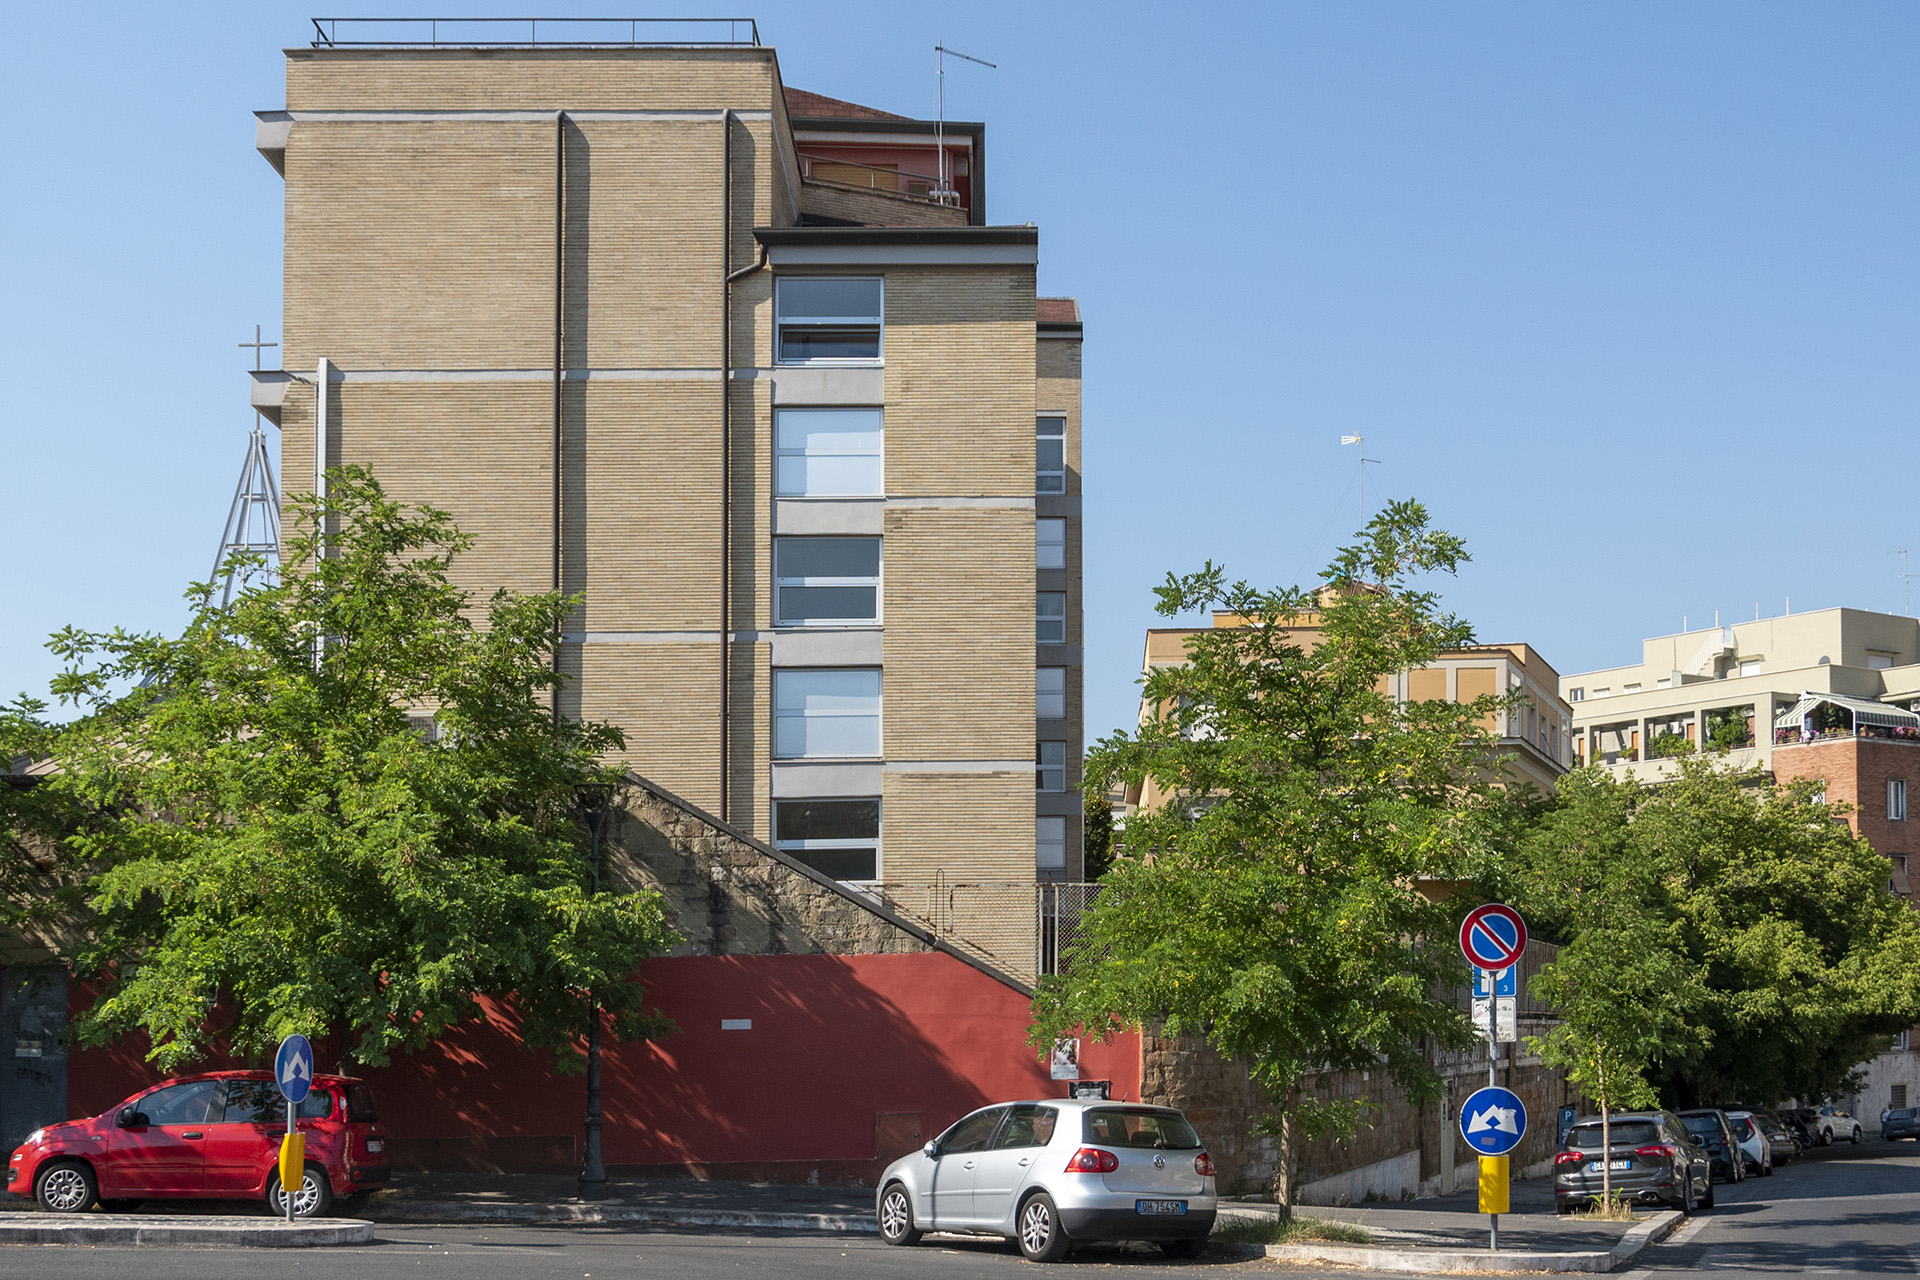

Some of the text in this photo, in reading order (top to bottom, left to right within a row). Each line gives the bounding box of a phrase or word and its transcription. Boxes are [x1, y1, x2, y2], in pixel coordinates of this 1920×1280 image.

[1503, 984, 1508, 992] 3
[1565, 1111, 1572, 1120] P
[1142, 1201, 1153, 1212] DH
